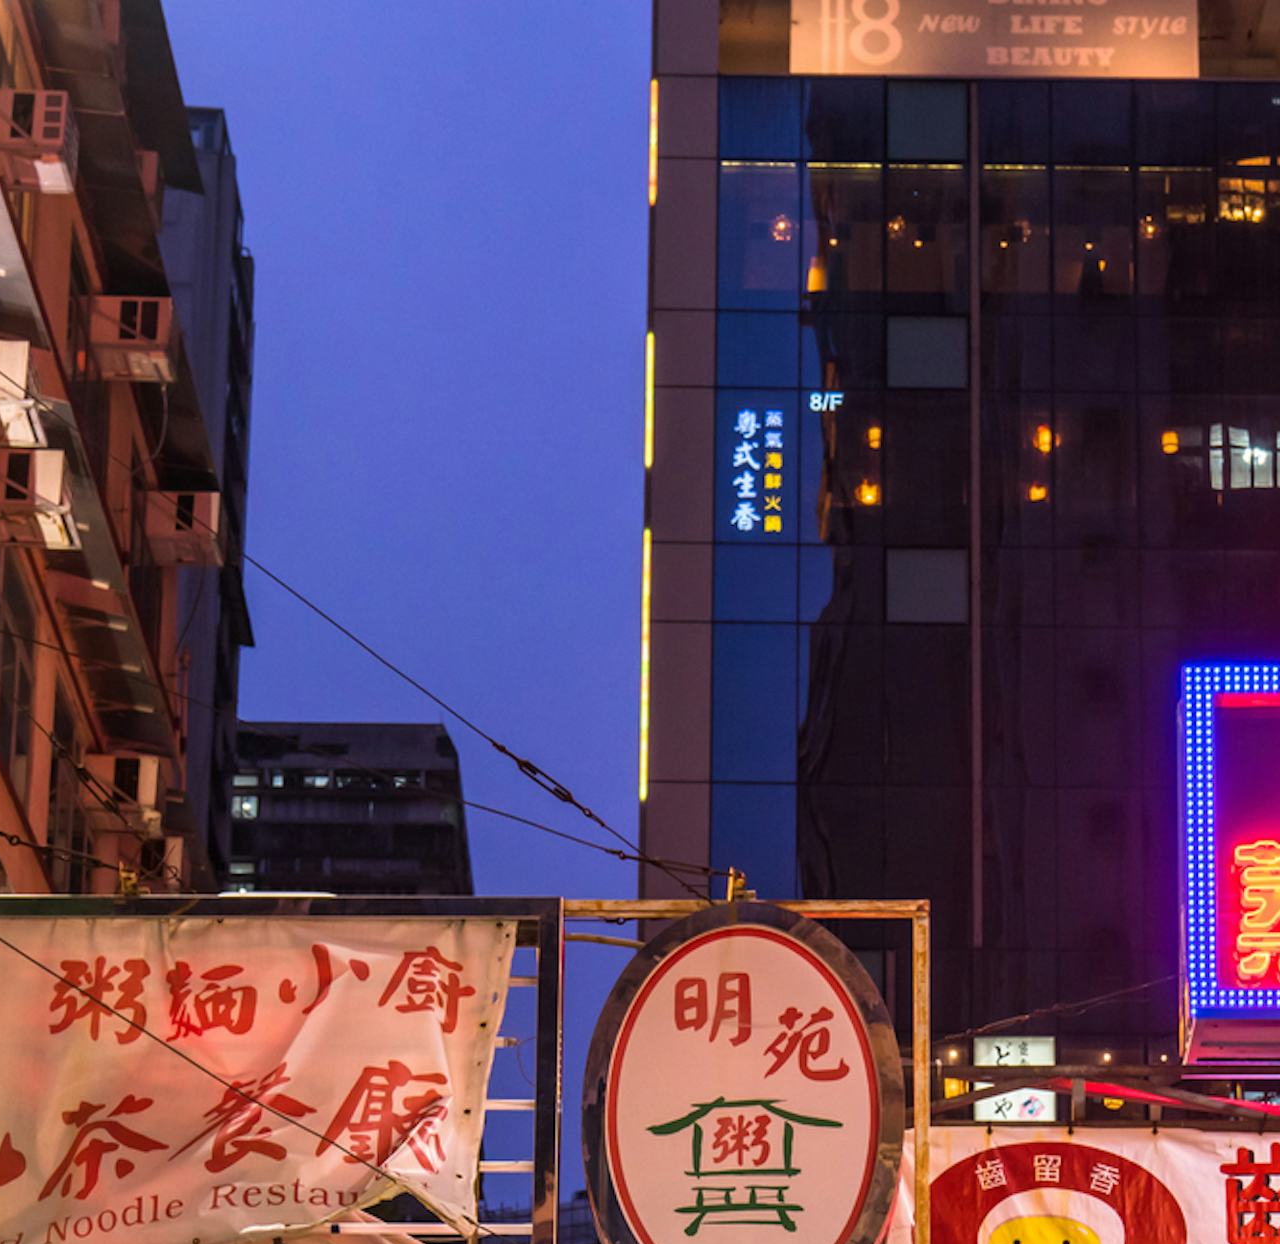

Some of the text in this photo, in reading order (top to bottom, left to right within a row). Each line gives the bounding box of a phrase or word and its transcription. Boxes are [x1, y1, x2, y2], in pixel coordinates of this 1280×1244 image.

[1010, 16, 1083, 35] LIFE
[986, 47, 1114, 67] BEAUTY
[809, 392, 843, 412] 8/F
[673, 971, 850, 1082] 明苑
[38, 1060, 455, 1203] 茶餐廳
[710, 1115, 772, 1168] 粥
[974, 1153, 1120, 1196] 齒留香
[47, 1193, 185, 1242] Noodle
[210, 1178, 360, 1212] Restau
